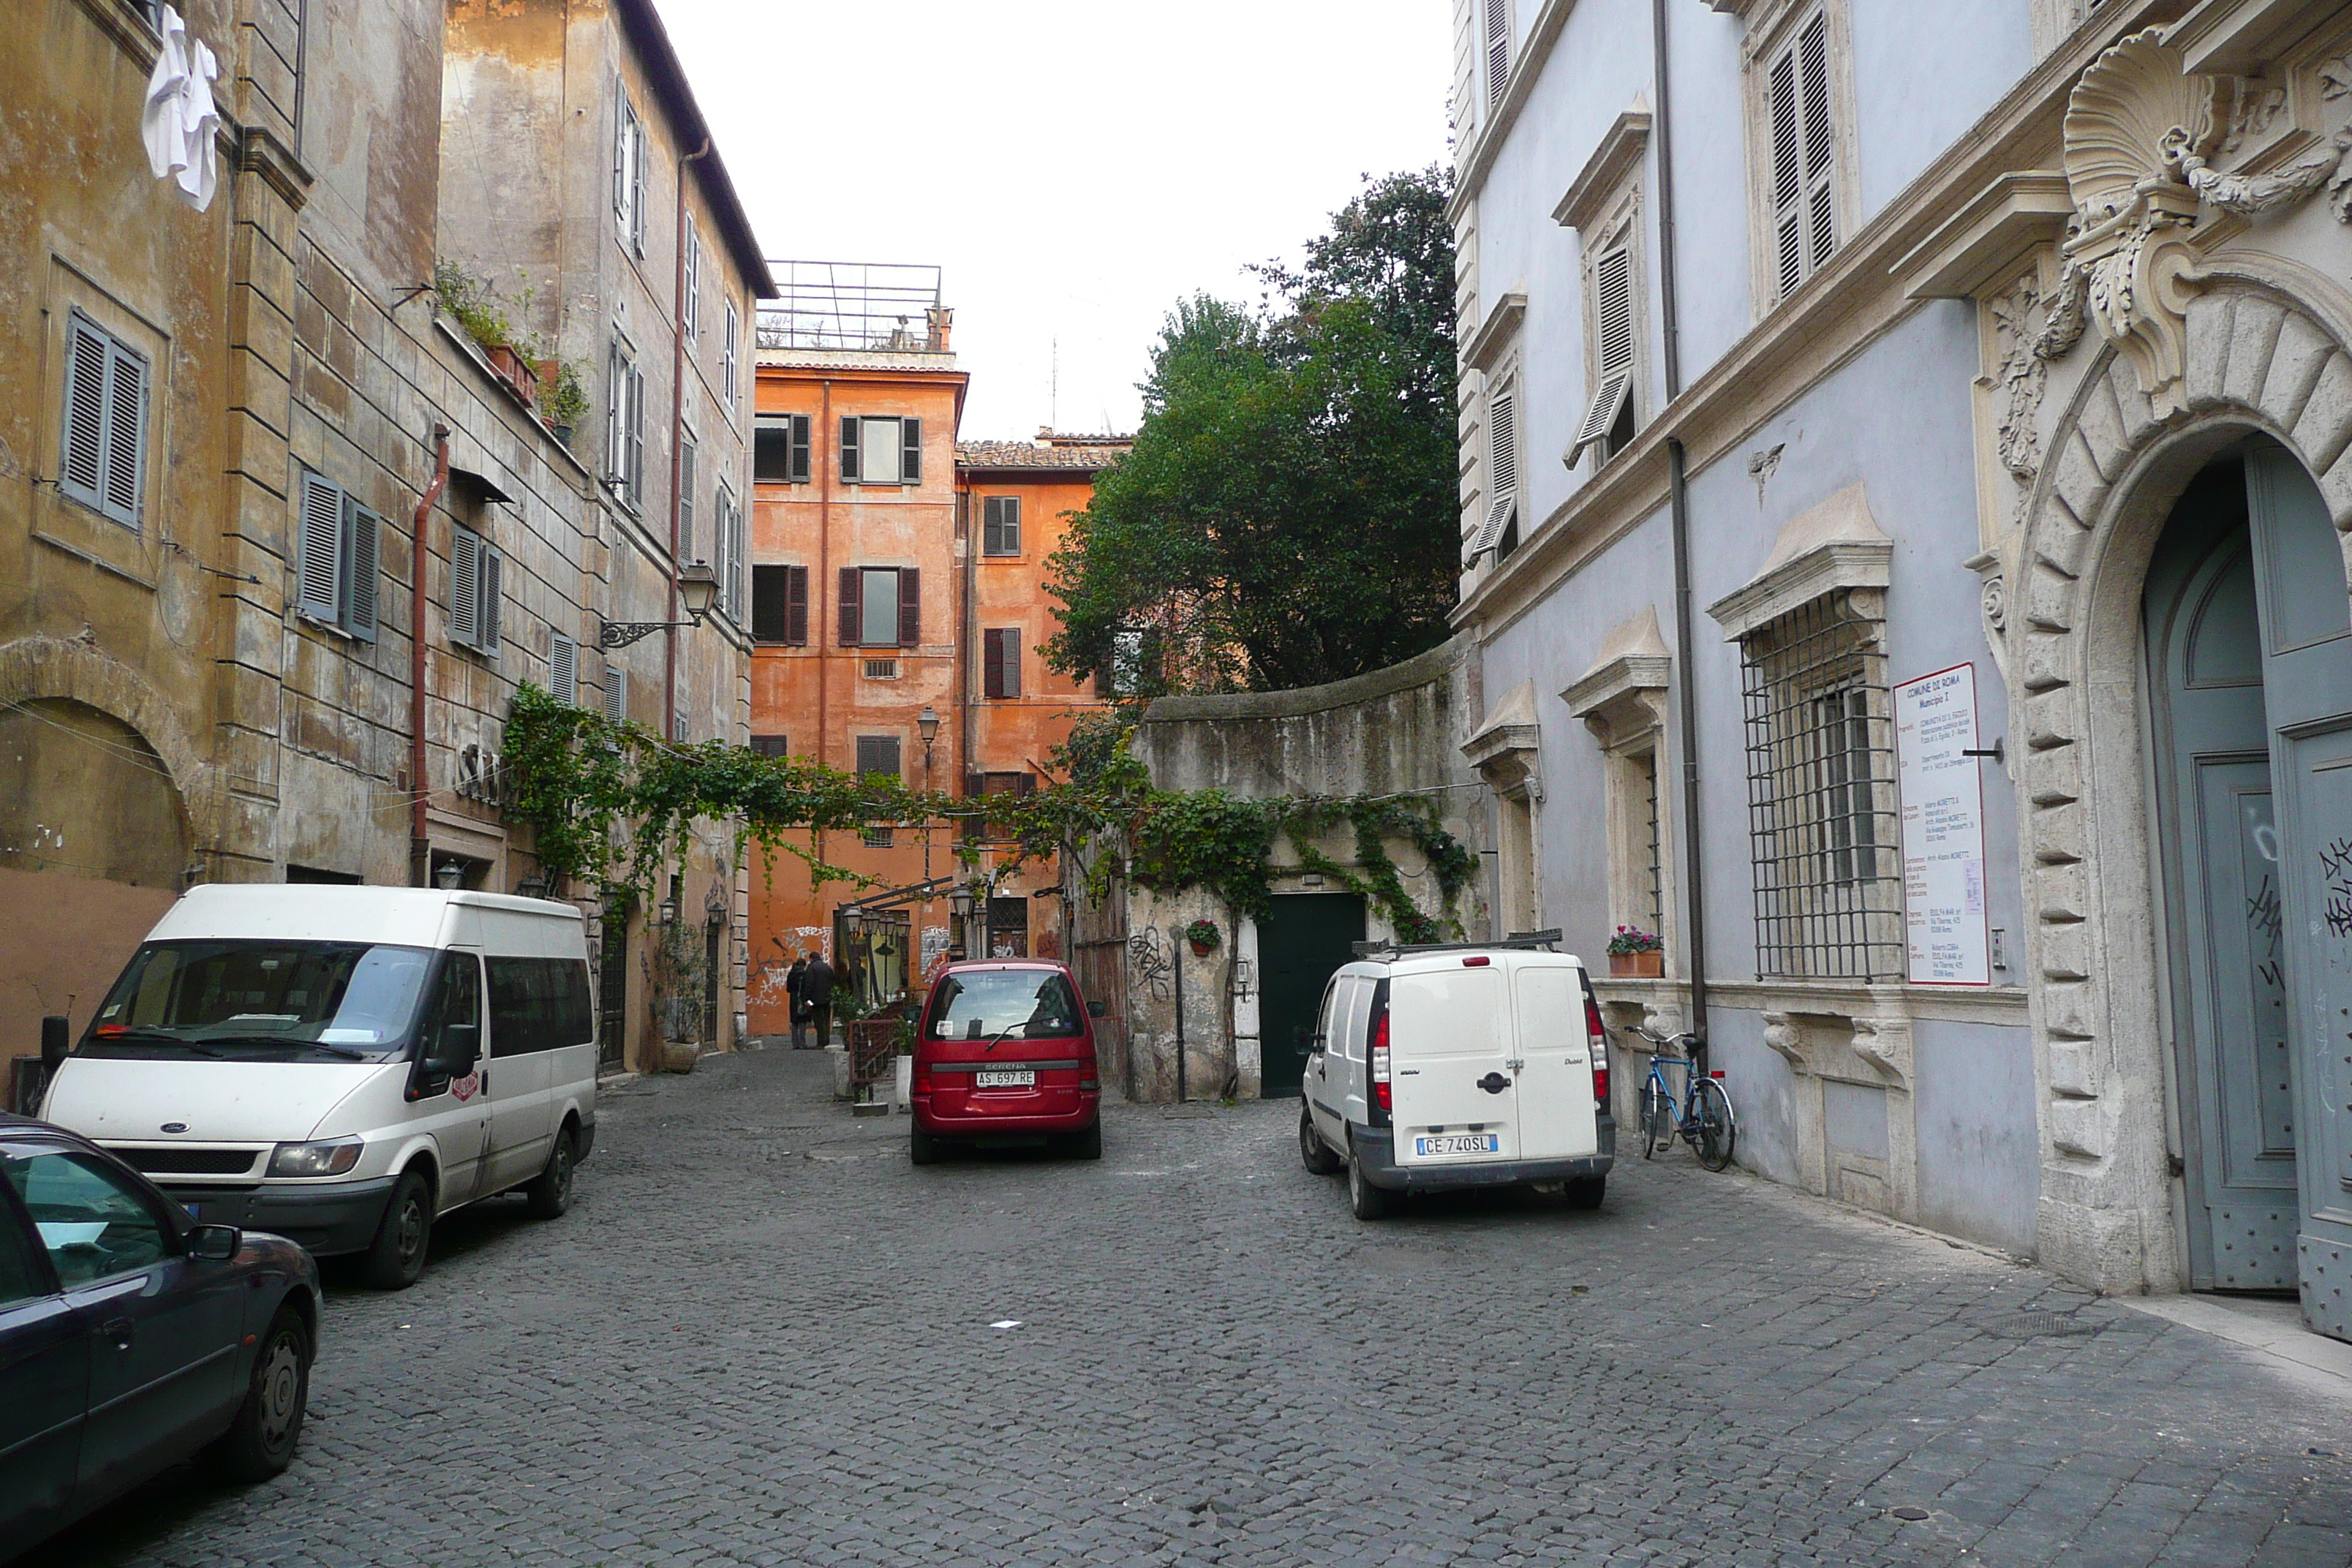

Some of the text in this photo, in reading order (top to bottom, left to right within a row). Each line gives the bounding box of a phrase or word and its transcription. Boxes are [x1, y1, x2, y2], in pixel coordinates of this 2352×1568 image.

[1907, 675, 1960, 698] COMUNE DI ROMA
[1920, 692, 1949, 708] Municipio I
[1937, 797, 1955, 806] MORETTI
[1948, 813, 1967, 821] MORETTI
[1950, 851, 1969, 859] MORETTI
[979, 1072, 1033, 1084] AS 697 RE
[1426, 1137, 1488, 1153] CE 740SL
